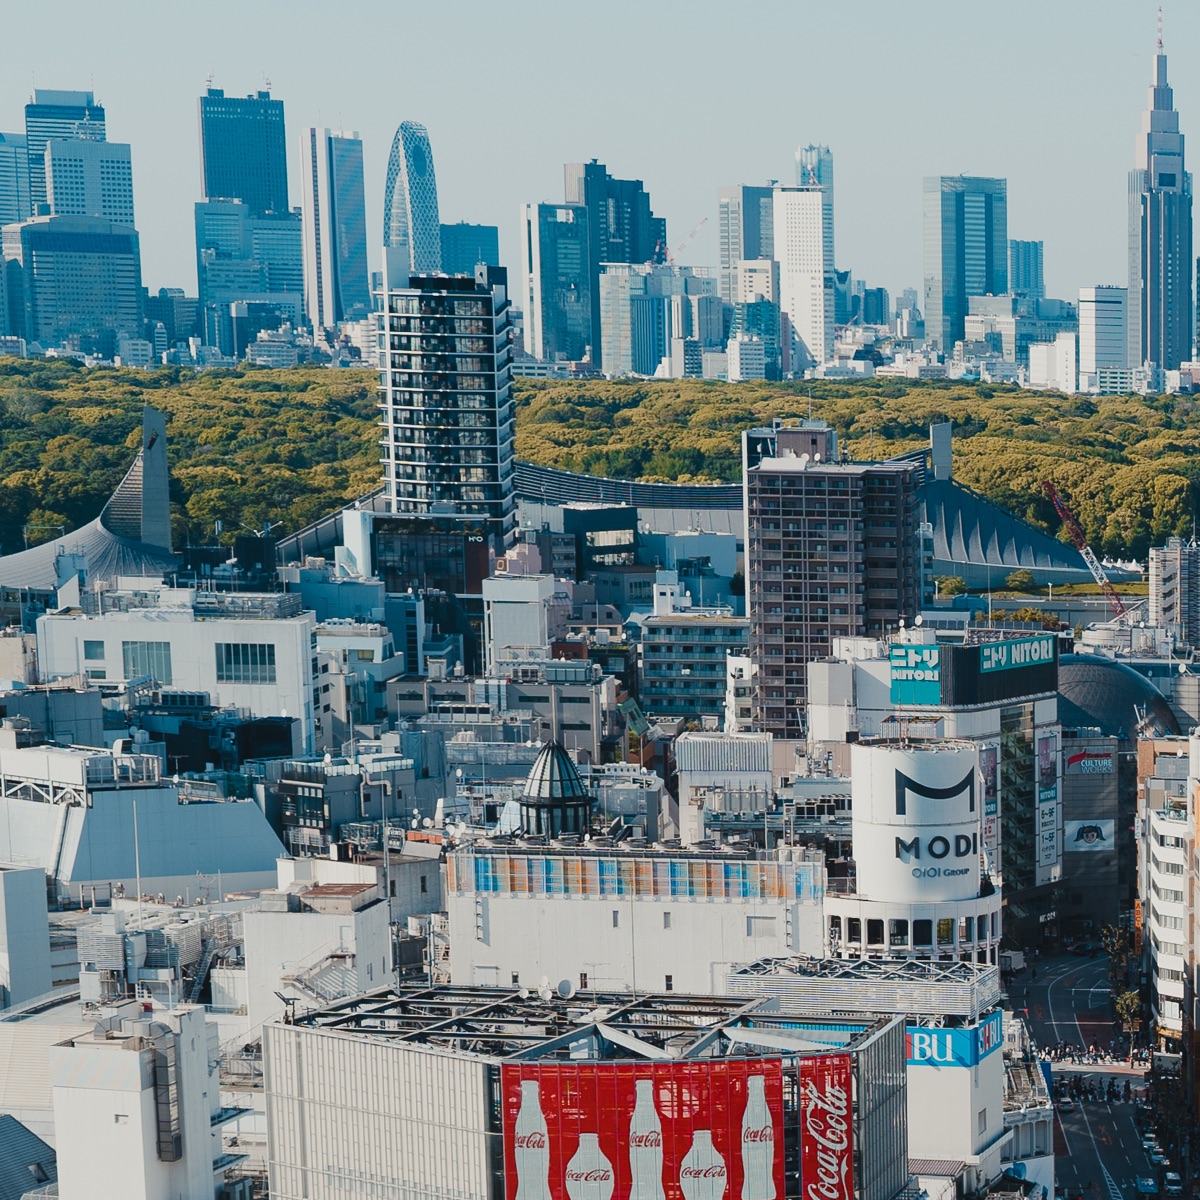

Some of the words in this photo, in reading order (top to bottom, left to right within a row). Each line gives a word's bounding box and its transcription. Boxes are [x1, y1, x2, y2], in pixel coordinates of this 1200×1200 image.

[891, 647, 940, 668] ニトリ
[983, 645, 1008, 670] ニトリ
[1011, 637, 1054, 665] NITORI
[891, 669, 940, 682] NITORI
[1080, 758, 1113, 767] CULTURE
[1081, 766, 1113, 775] WORKS
[1040, 788, 1057, 800] NITORI
[895, 832, 978, 860] MODI
